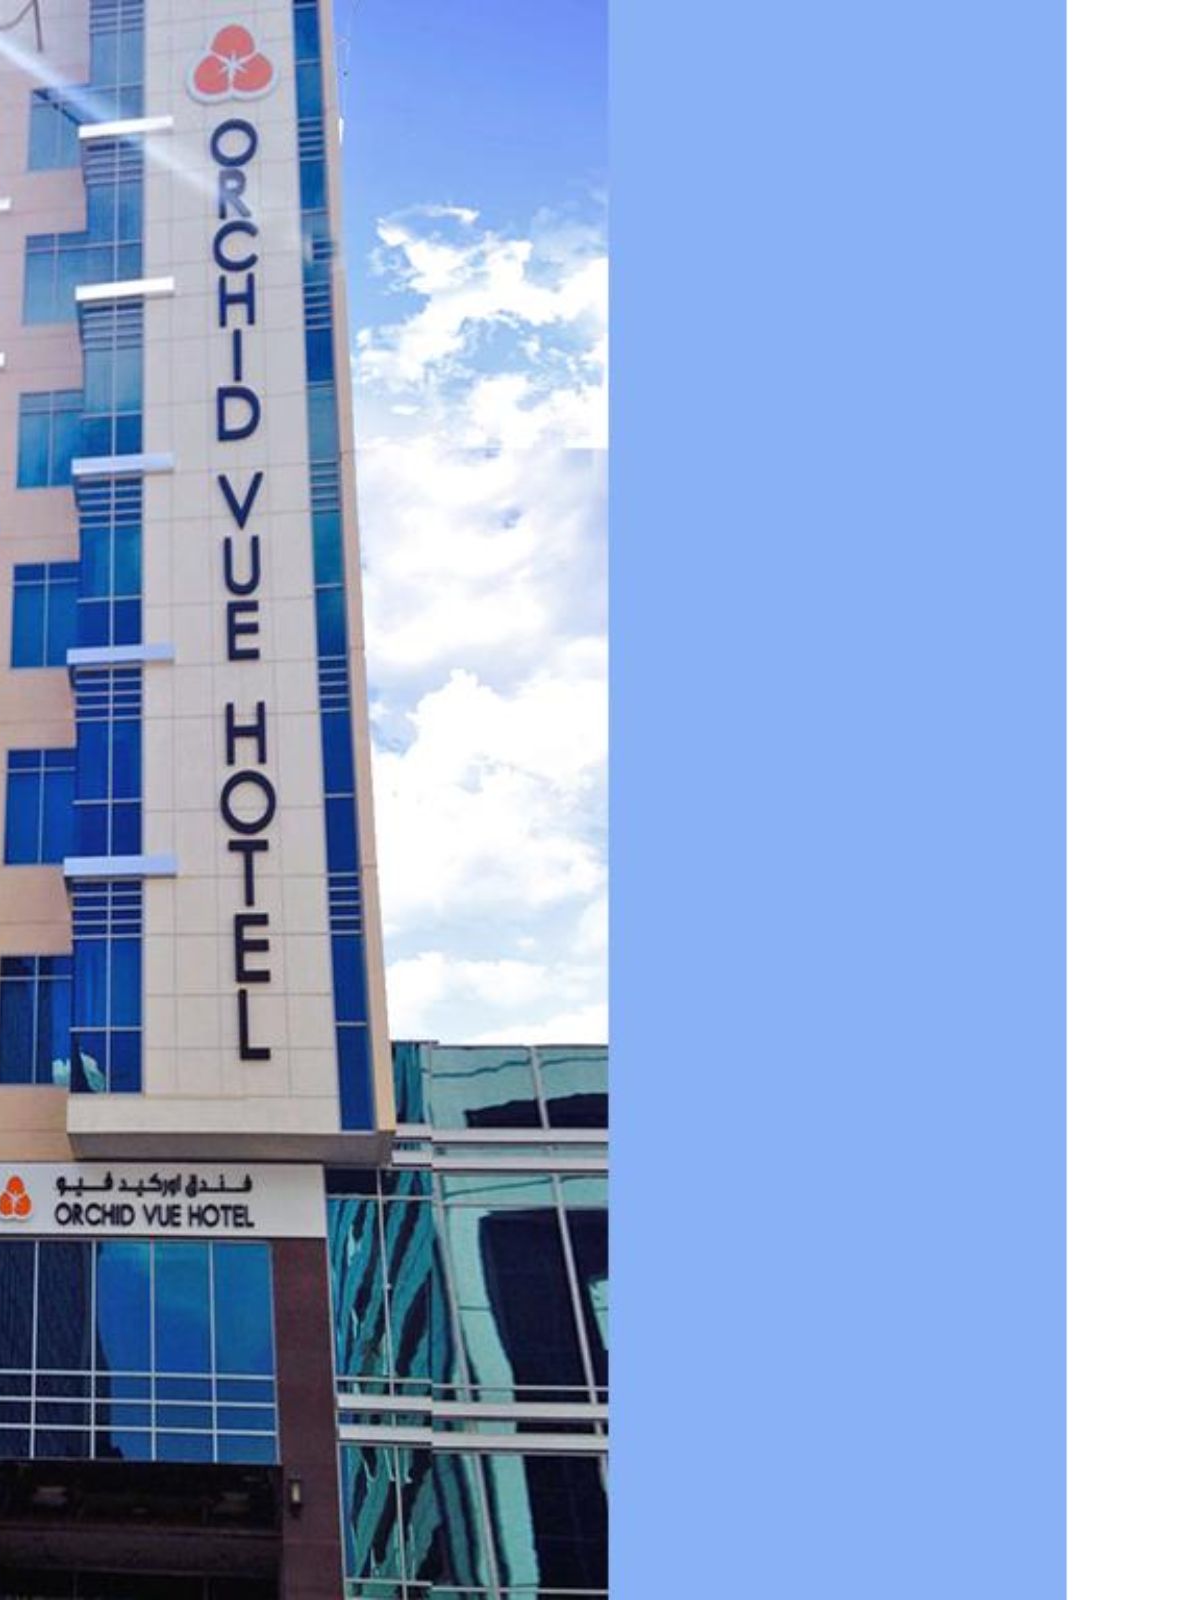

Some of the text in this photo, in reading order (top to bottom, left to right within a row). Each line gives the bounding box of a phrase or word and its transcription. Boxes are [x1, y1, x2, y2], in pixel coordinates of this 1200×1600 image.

[210, 118, 277, 1062] ORCHID VUE HOTEL
[184, 1172, 254, 1199] فندق
[53, 1201, 256, 1229] ORCHID VUE HOTEL
